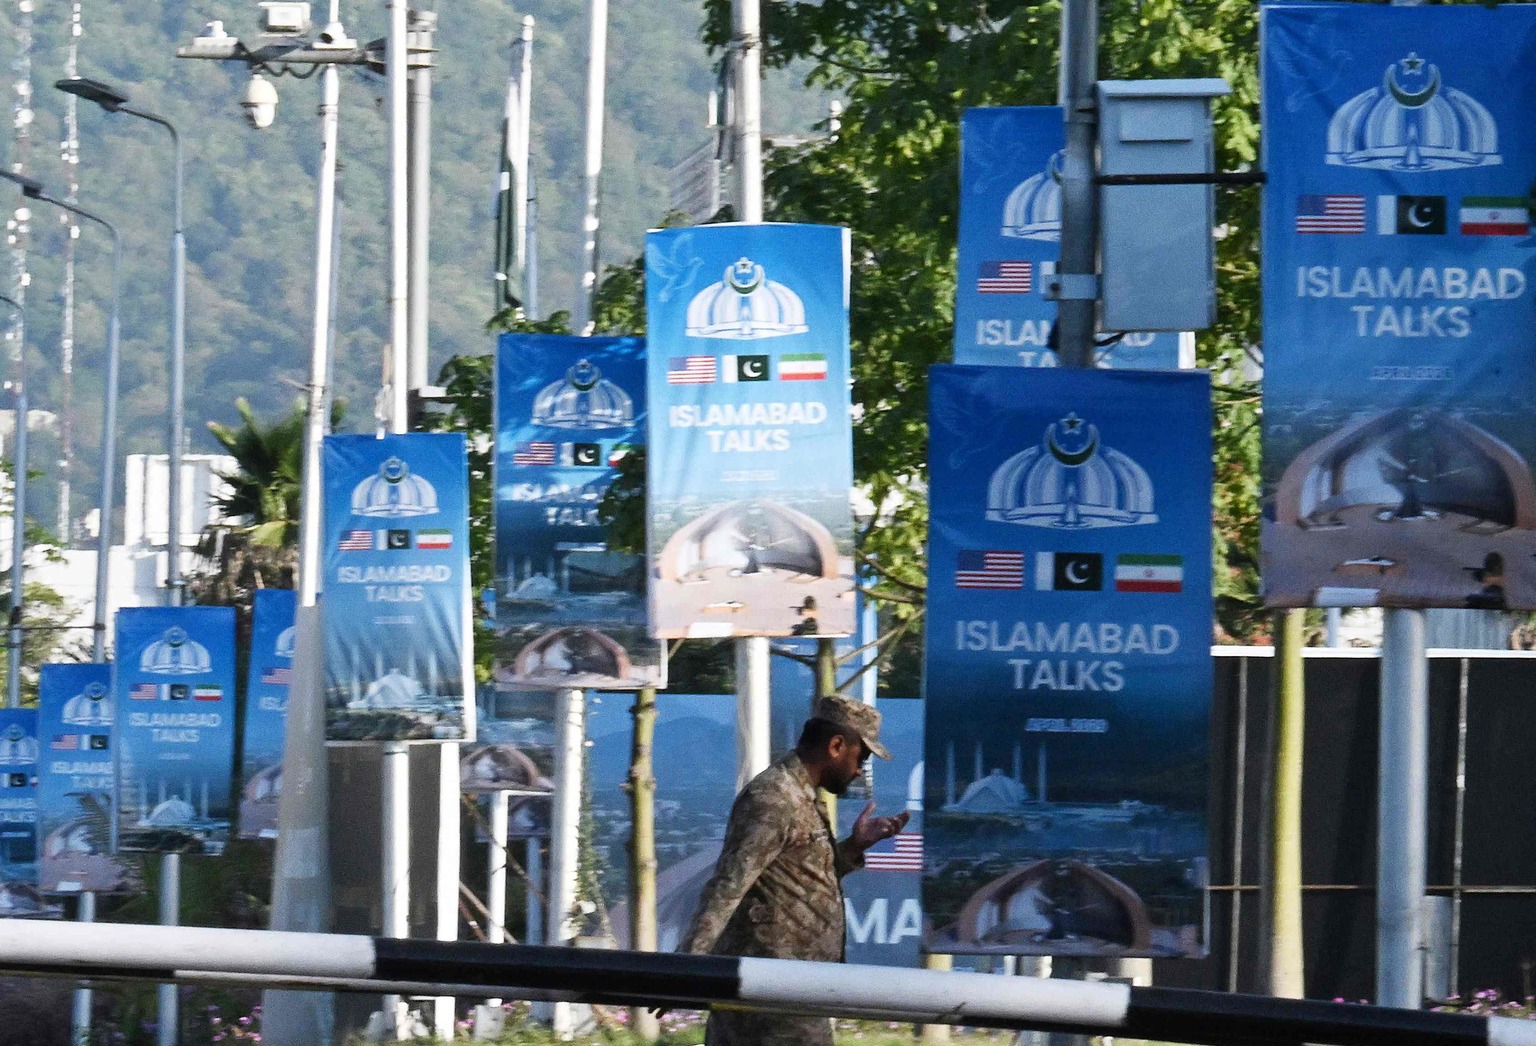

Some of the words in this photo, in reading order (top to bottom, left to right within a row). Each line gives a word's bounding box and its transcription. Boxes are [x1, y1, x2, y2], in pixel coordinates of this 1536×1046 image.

[1296, 265, 1527, 300] ISLAMABAD
[1350, 304, 1472, 338] TALKS
[669, 401, 828, 428] ISLAMABAD
[706, 428, 791, 453] TALKS
[337, 565, 452, 583] ISLAMABAD
[365, 585, 424, 602] TALKS
[955, 620, 1181, 655] ISLAMABAD
[1007, 658, 1126, 692] TALKS
